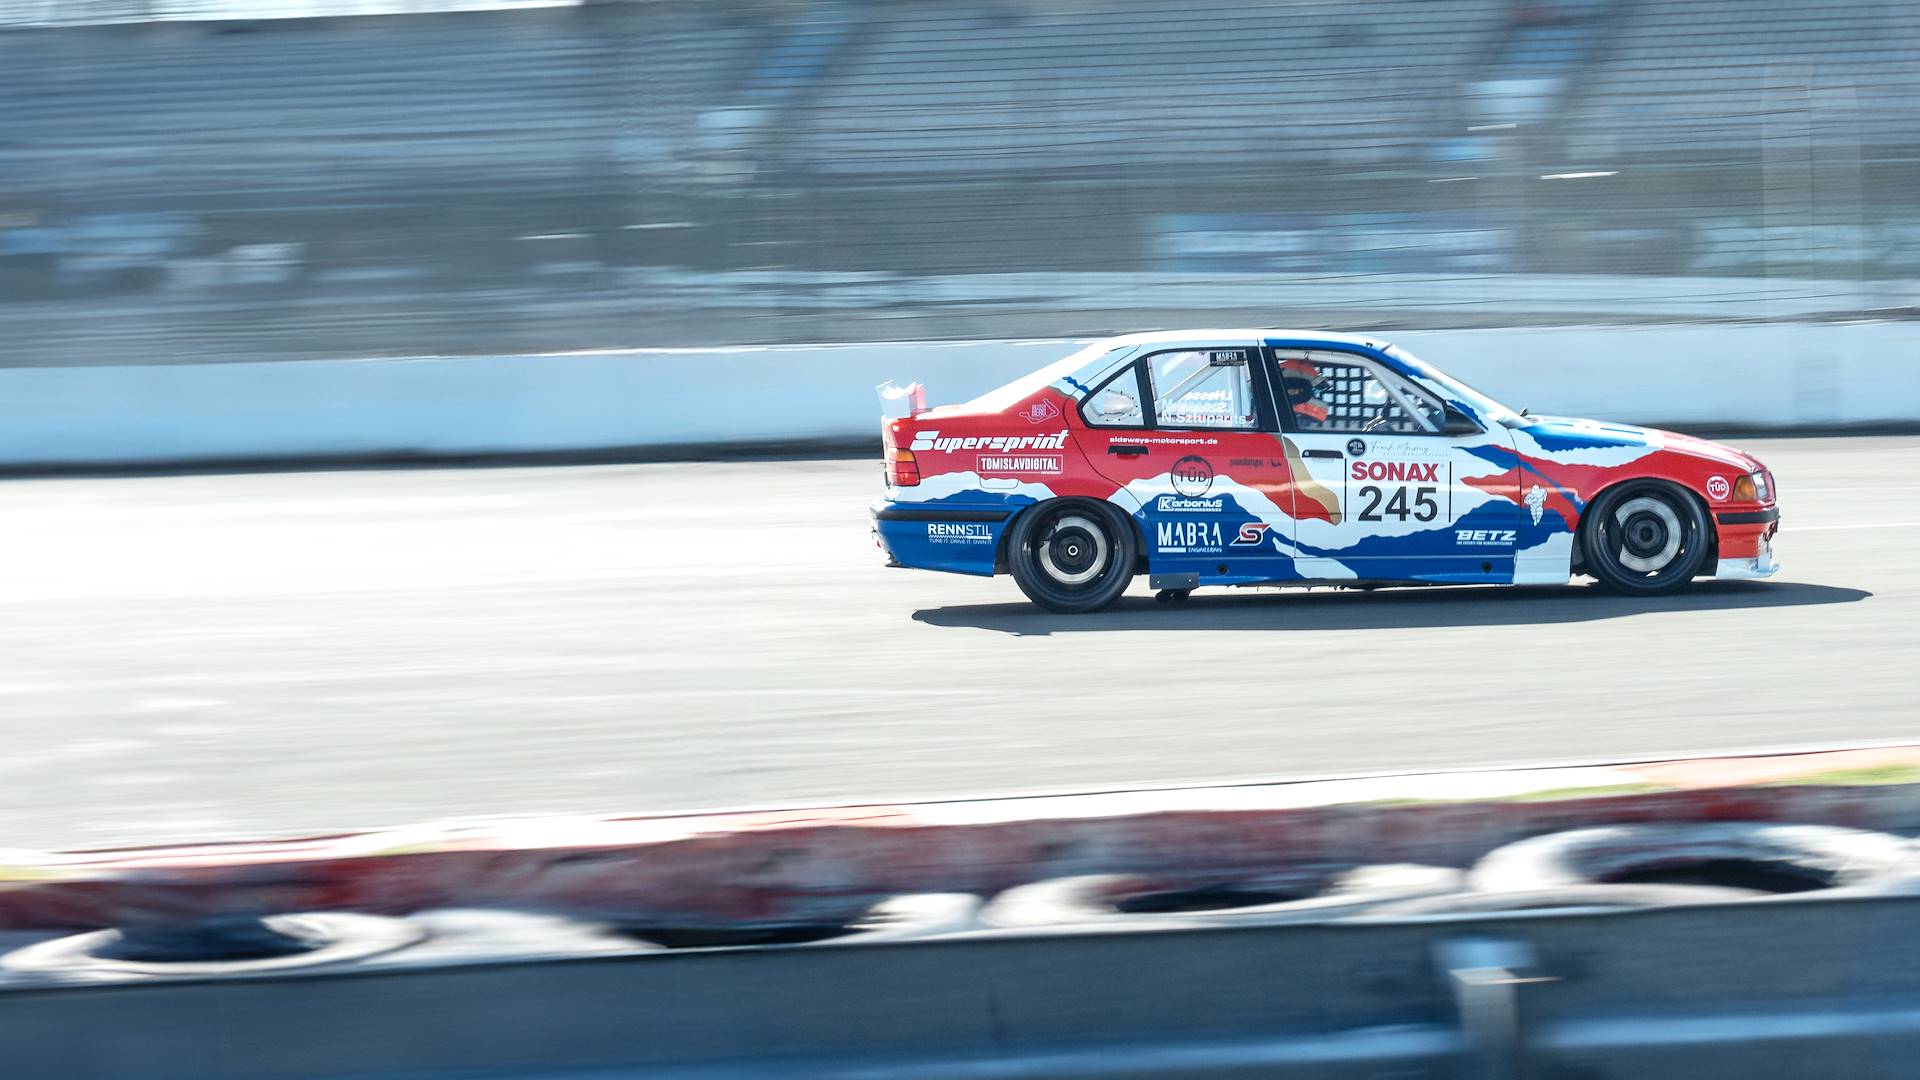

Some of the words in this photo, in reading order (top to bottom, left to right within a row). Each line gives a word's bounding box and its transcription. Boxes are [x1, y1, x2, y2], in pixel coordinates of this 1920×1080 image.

[910, 429, 1069, 453] Supersprint
[1109, 436, 1218, 445] sideways-motorsport.de
[981, 457, 1059, 470] TOMISLAVDIGITAL
[1351, 461, 1439, 482] SONAX
[1159, 497, 1223, 510] Karbonius
[1357, 485, 1438, 522] 245
[927, 523, 993, 536] RENNSTIL
[1157, 522, 1223, 546] MABRA
[1454, 529, 1517, 541] BETZ
